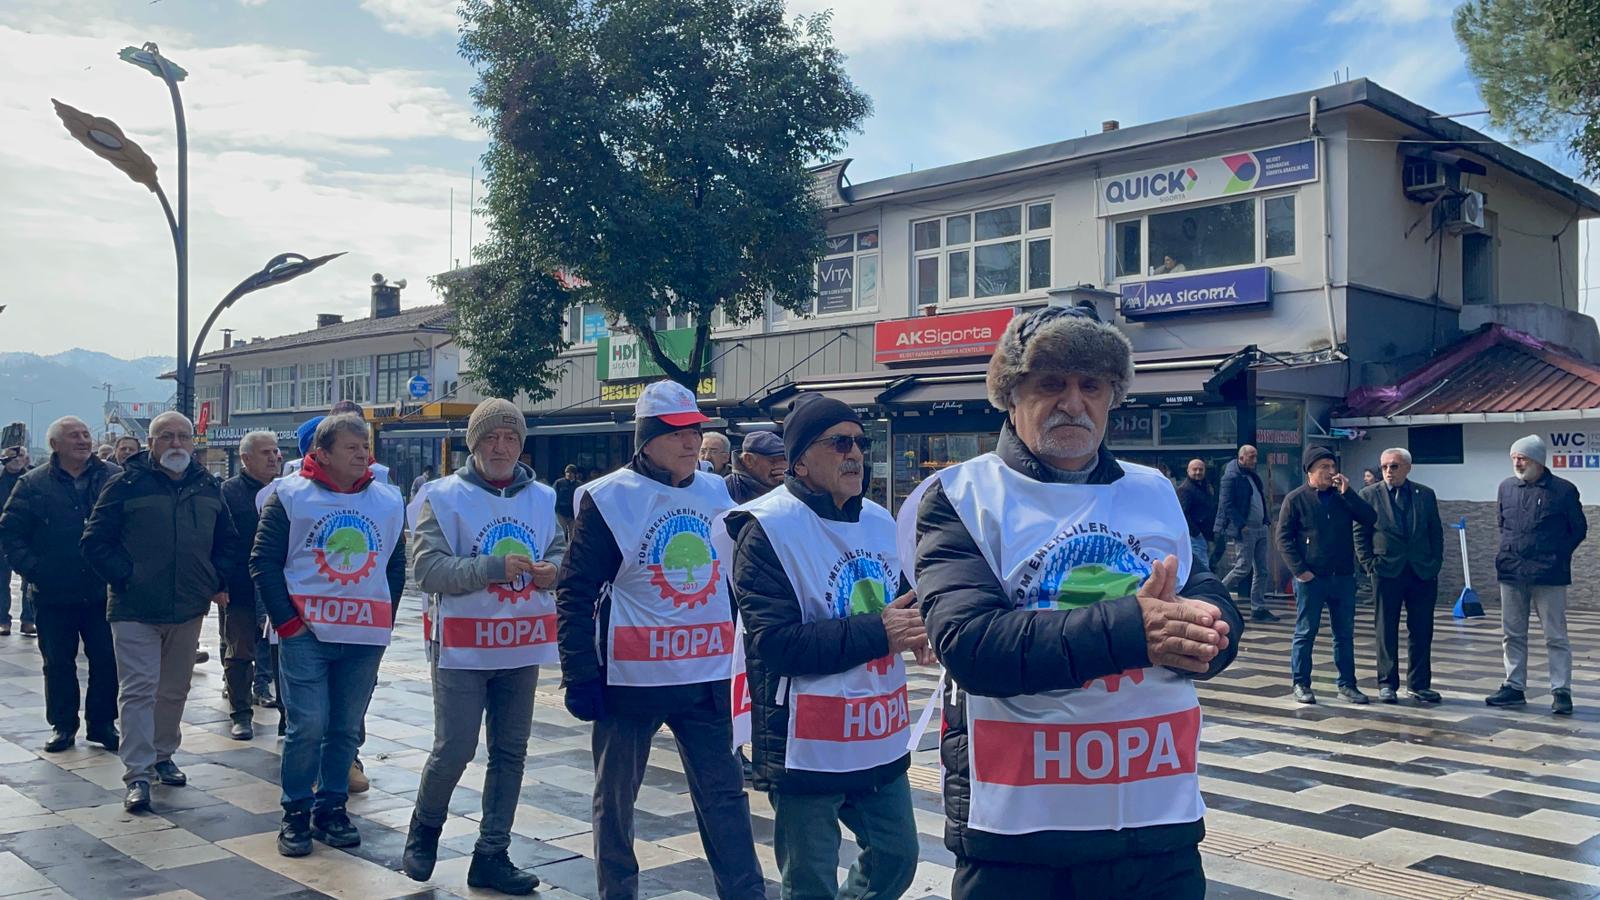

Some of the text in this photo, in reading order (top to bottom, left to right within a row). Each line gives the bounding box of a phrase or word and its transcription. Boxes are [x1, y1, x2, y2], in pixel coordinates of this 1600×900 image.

[1106, 169, 1186, 203] QUICK
[1124, 297, 1142, 309] AXA
[1146, 293, 1175, 308] AXA
[612, 344, 637, 361] HDI
[1550, 432, 1585, 447] WC
[681, 583, 699, 591] 2017
[304, 598, 374, 625] HOPA
[476, 618, 547, 646] HOPA
[650, 626, 724, 658] HOPA
[843, 692, 907, 738] HOPA
[1033, 721, 1182, 779] HOPA
